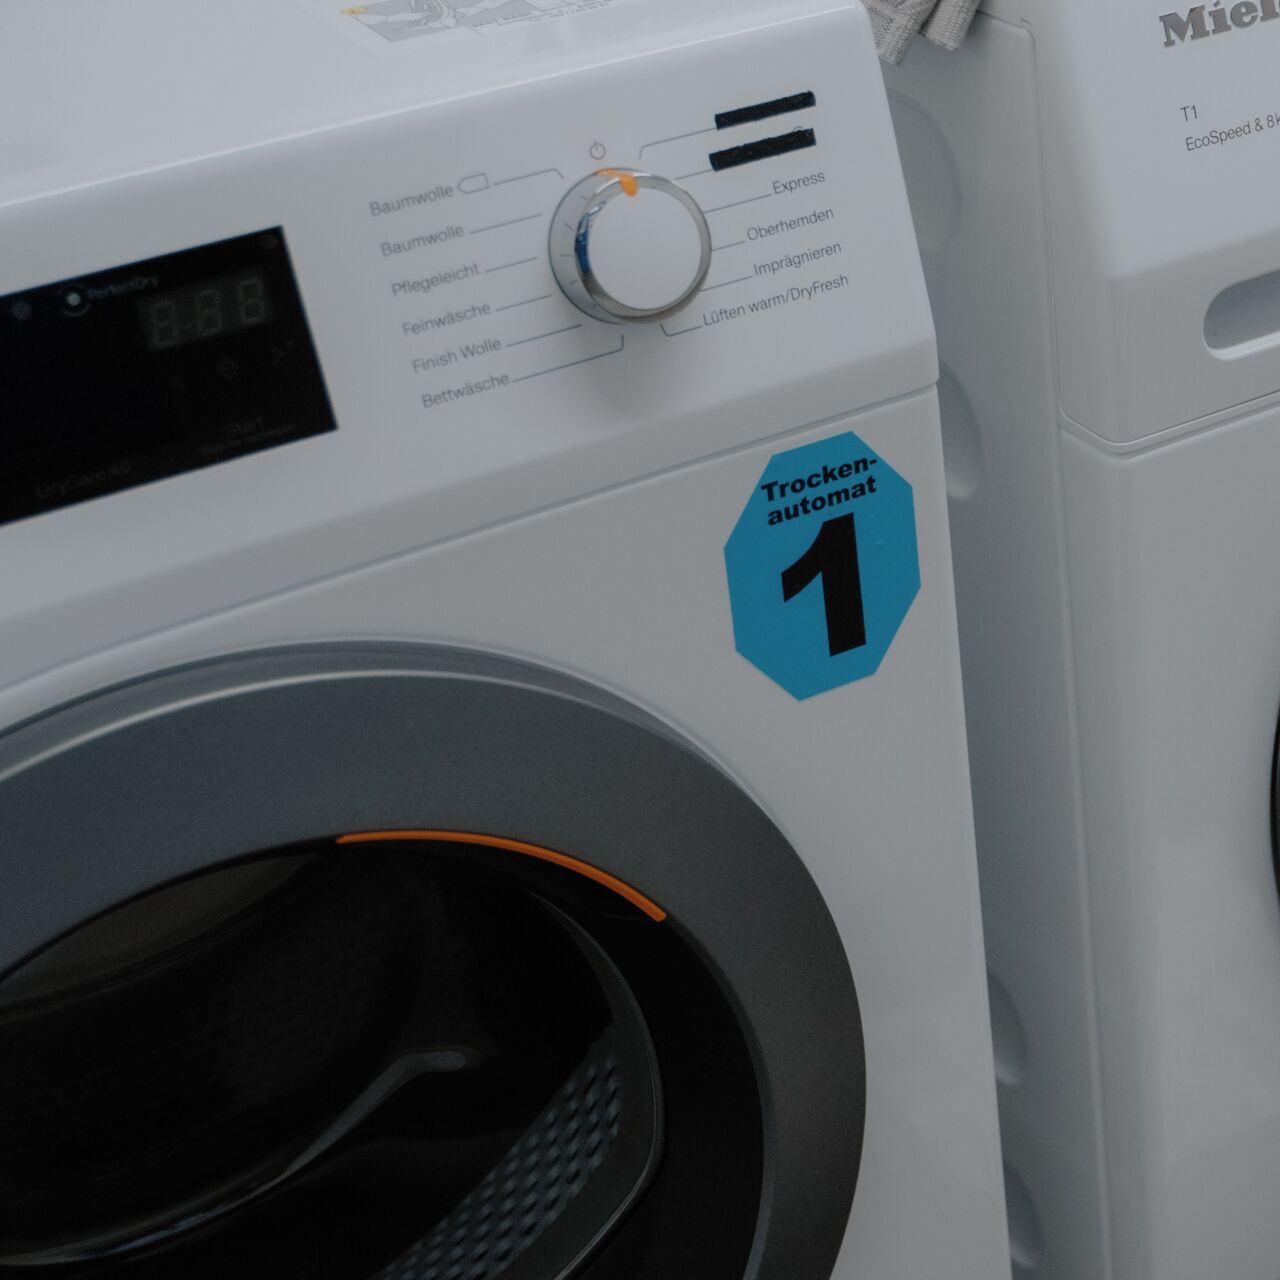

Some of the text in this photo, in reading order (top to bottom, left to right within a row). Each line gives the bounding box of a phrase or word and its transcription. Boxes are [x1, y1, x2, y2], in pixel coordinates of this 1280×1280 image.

[1180, 104, 1198, 122] T1
[1185, 121, 1251, 151] EcoSpeed
[1254, 117, 1264, 133] &
[368, 184, 455, 217] Baumwolle
[772, 171, 826, 197] Express
[379, 224, 465, 258] Baumwolle
[746, 207, 834, 241] Oberhemden
[753, 242, 842, 278] Imprägnieren
[391, 262, 479, 298] Pflegeleicht
[702, 273, 849, 328] Lüften warm/DryFresh
[402, 301, 491, 337] Feinwäsche
[412, 337, 502, 375] Finish Wolle
[421, 372, 510, 409] Bettwäsche
[761, 458, 877, 502] Trocken-
[767, 475, 877, 526] automat
[781, 512, 866, 657] 1
